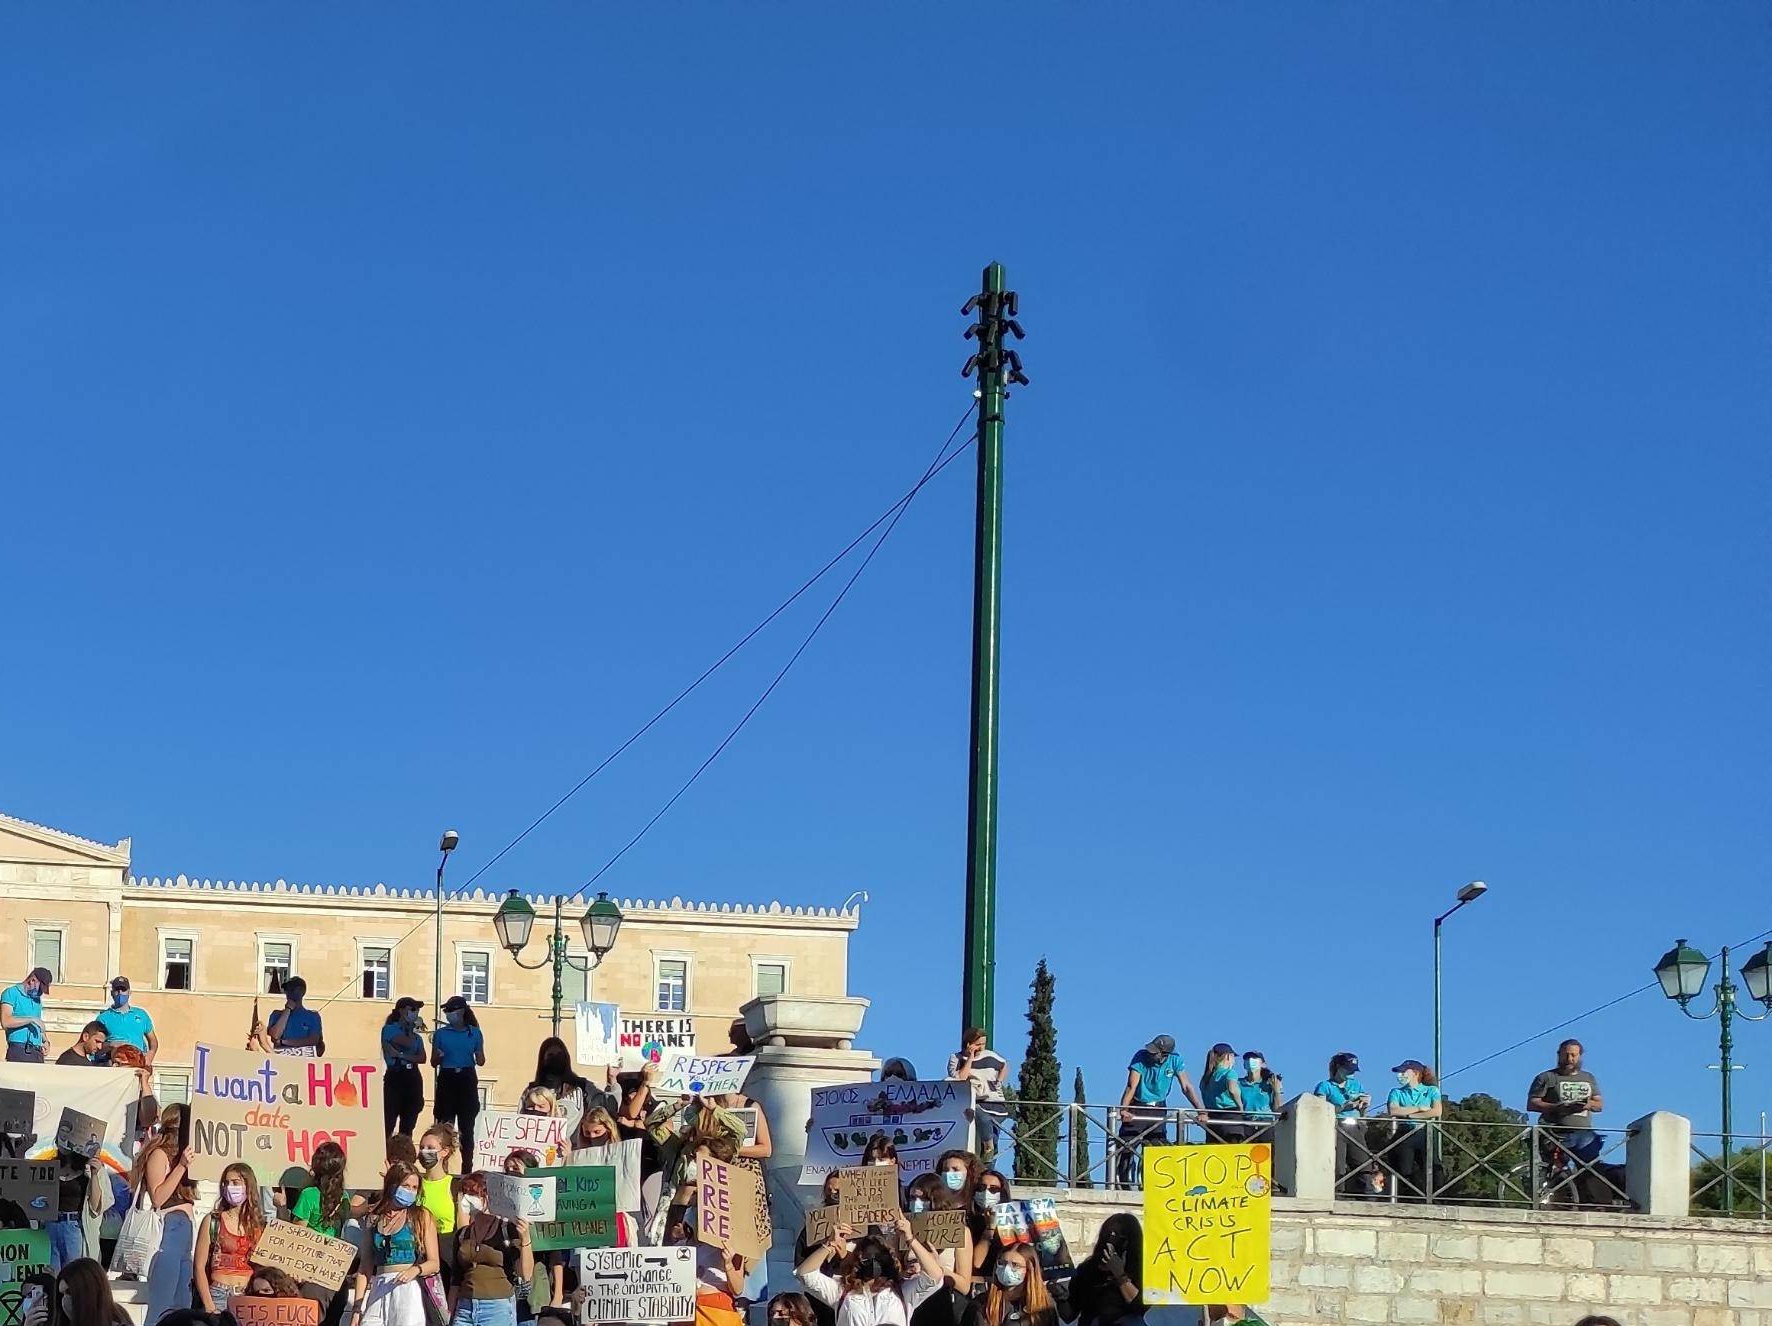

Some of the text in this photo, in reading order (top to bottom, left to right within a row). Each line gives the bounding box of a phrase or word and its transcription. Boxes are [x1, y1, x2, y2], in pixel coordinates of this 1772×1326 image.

[622, 1018, 692, 1033] THERE IS
[620, 1033, 695, 1047] NO PLANET
[650, 1048, 661, 1063] B
[674, 1056, 750, 1075] RESPECT
[195, 1046, 210, 1096] I
[213, 1059, 277, 1104] want
[282, 1083, 303, 1105] a
[244, 1104, 291, 1130] date
[194, 1118, 272, 1159] NOT a
[484, 1116, 567, 1145] WE SPEAK
[479, 1140, 495, 1150] FOR
[479, 1153, 505, 1167] THE
[702, 1159, 728, 1186] RE
[840, 1169, 867, 1179] WHEN
[1153, 1152, 1252, 1188] STOP
[576, 1178, 599, 1192] KIDS
[850, 1178, 888, 1187] ACT LIKE
[703, 1184, 730, 1212] RE
[856, 1187, 883, 1197] KIDS
[589, 1200, 597, 1209] A
[1165, 1195, 1249, 1212] CLIMATE
[703, 1210, 730, 1239] RE
[850, 1208, 895, 1224] LEADERS
[1173, 1214, 1236, 1231] CRISIS
[287, 1226, 323, 1244] SHOULD
[572, 1219, 608, 1236] PLANET
[269, 1236, 285, 1247] FOR
[297, 1244, 326, 1259] FUTURE
[326, 1255, 345, 1267] THAT
[1153, 1228, 1252, 1264] ACT
[294, 1259, 318, 1273] EVEN
[1169, 1264, 1255, 1295] NOW
[276, 1305, 316, 1323] FUCK
